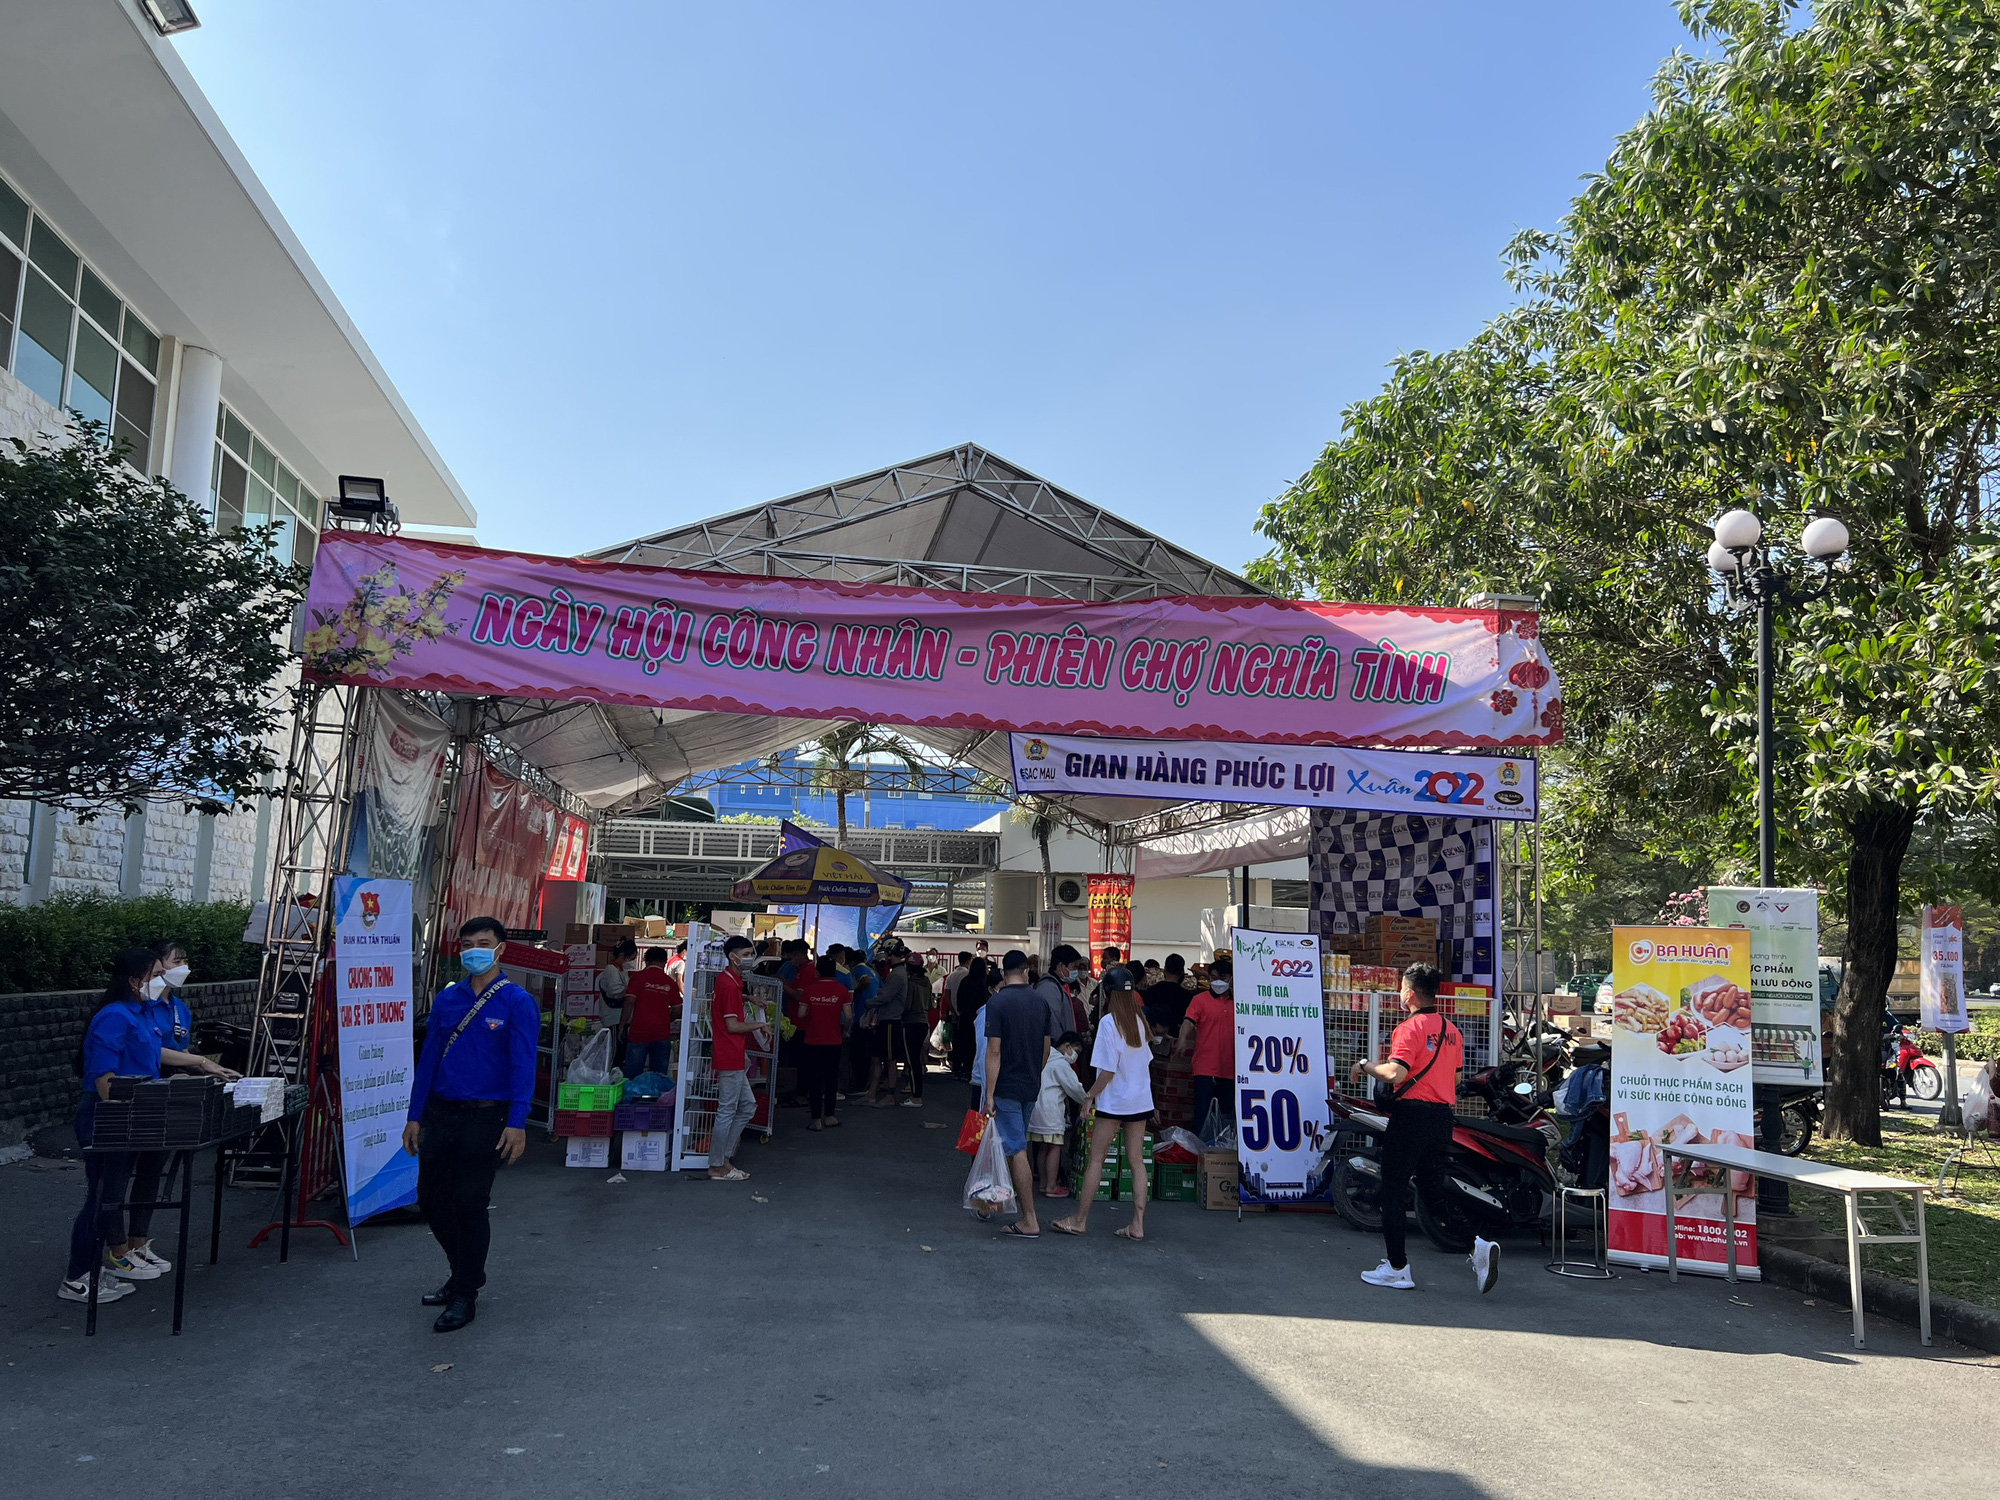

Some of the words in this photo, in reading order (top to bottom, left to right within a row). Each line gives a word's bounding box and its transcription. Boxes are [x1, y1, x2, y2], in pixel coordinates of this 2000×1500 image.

[474, 587, 603, 654] NGÀY
[606, 599, 693, 676] HỘI
[699, 613, 817, 671] CÔNG
[823, 619, 951, 681] NHÂN
[985, 622, 1116, 689] PHIÊN
[1121, 634, 1211, 708] CHỢ
[1211, 636, 1341, 700] NGHĨA
[1350, 638, 1452, 704] TÌNH
[1065, 752, 1130, 779] GIAN
[1136, 749, 1209, 785] HÀNG
[1214, 755, 1292, 790] PHÚC
[1297, 761, 1336, 794] LỢI
[1346, 769, 1414, 796] Xuân
[1413, 769, 1485, 806] 2022
[369, 933, 380, 945] TÂN
[381, 933, 401, 946] THUẬN
[1656, 944, 1678, 957] BA
[1681, 942, 1729, 959] HUÂN
[1271, 959, 1314, 978] 2022
[1764, 962, 1793, 973] PHẨM
[1257, 984, 1272, 999] TRỢ
[1274, 984, 1289, 998] GIÁ
[1761, 979, 1778, 987] LƯU
[1781, 978, 1813, 989] ĐỘNG
[1236, 1000, 1250, 1015] SẢN
[1252, 1000, 1274, 1017] PHẨM
[1275, 1002, 1300, 1018] THIẾT
[1301, 1003, 1319, 1018] YẾU
[1248, 1035, 1310, 1075] 20%
[1620, 1074, 1651, 1086] CHUỖI
[1653, 1077, 1680, 1089] THỰC
[1682, 1076, 1712, 1090] PHẨM
[1715, 1082, 1743, 1094] SẠCH
[1617, 1088, 1627, 1099] VÌ
[1630, 1089, 1651, 1101] SỨC
[1654, 1091, 1681, 1102] KHỎE
[1684, 1092, 1713, 1105] CỘNG
[1716, 1095, 1747, 1108] ĐỒNG
[1241, 1089, 1325, 1152] 50%
[1697, 1225, 1721, 1235] 1800
